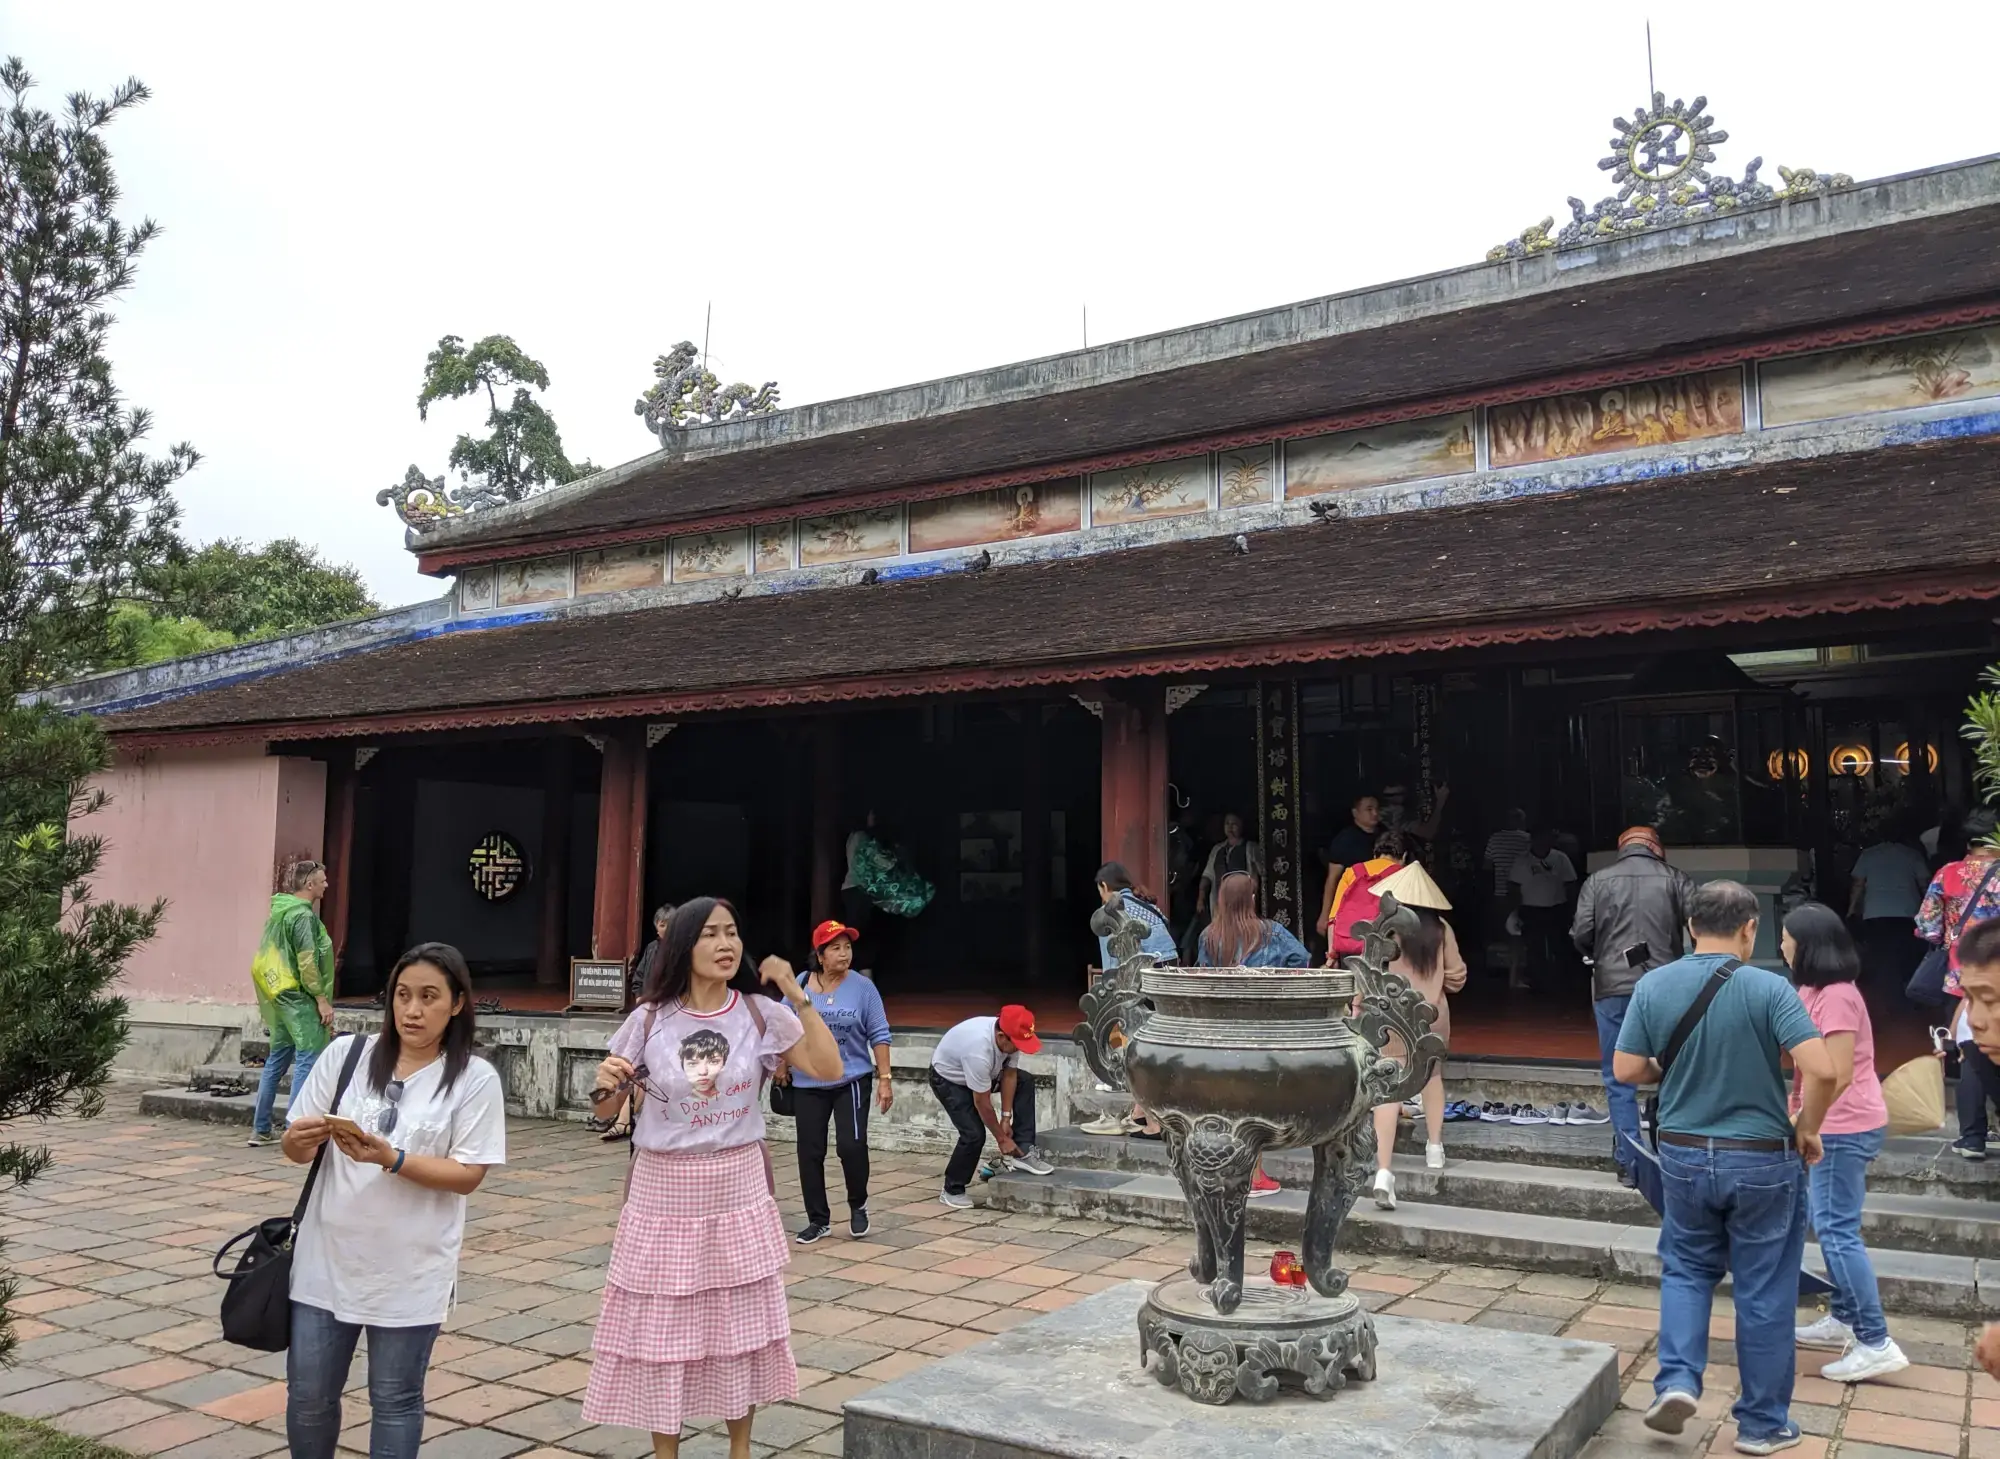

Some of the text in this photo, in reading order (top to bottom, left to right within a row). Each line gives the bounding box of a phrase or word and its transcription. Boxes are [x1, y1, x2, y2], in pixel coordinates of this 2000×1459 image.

[661, 1109, 670, 1121] I
[725, 1078, 752, 1097] CARE
[690, 1105, 751, 1129] ANYMORE
